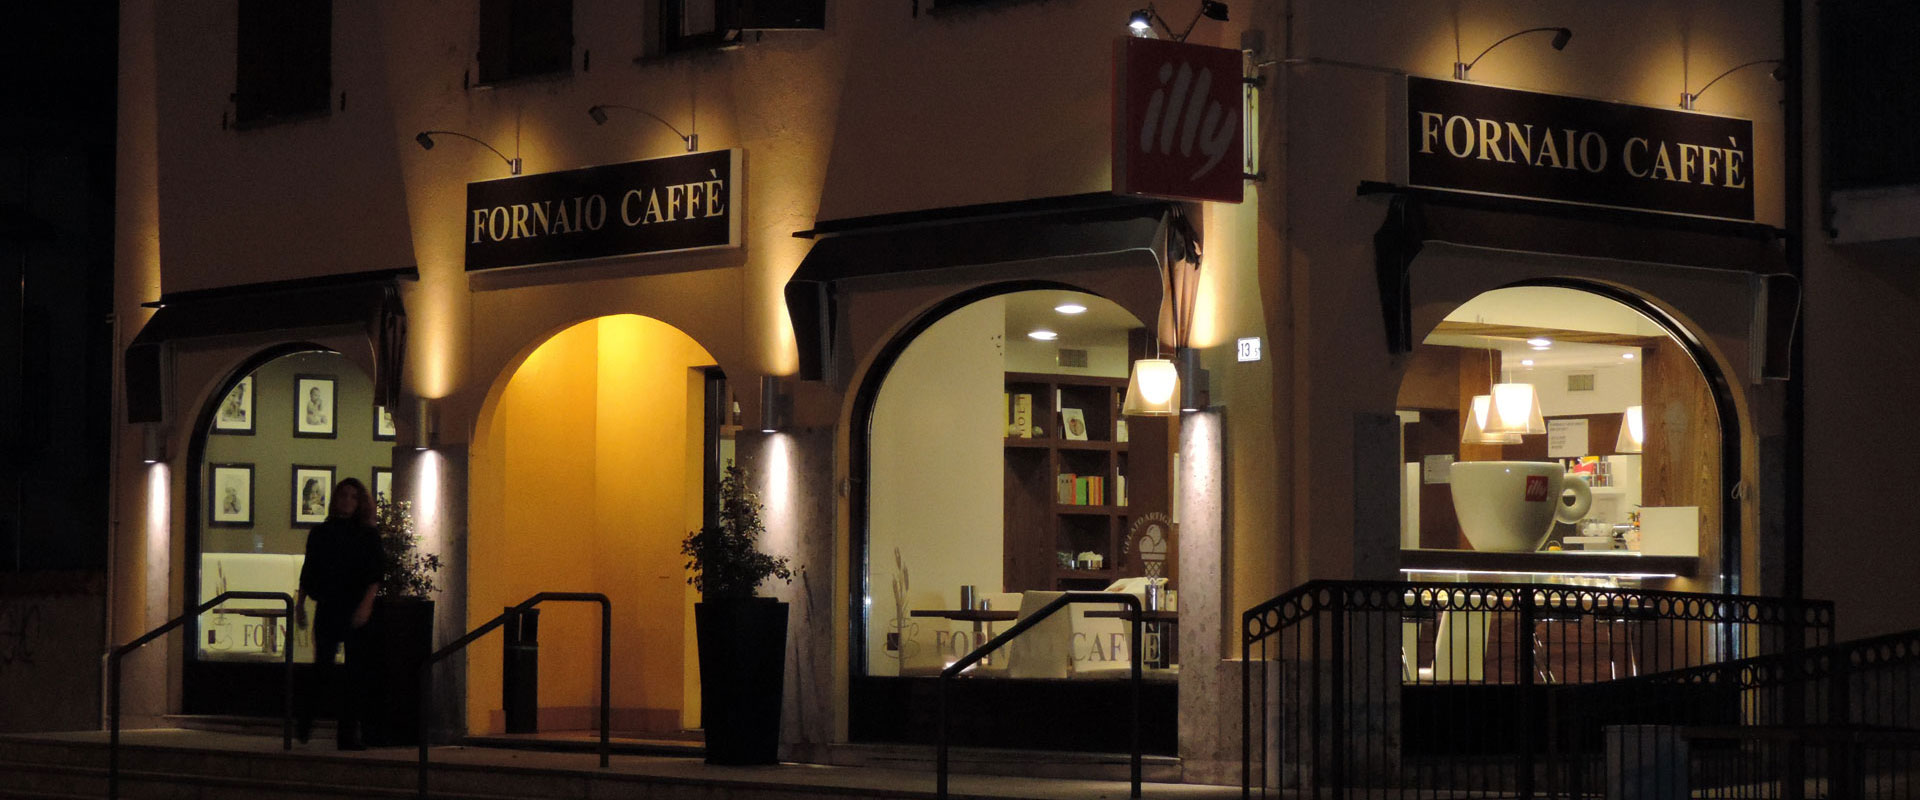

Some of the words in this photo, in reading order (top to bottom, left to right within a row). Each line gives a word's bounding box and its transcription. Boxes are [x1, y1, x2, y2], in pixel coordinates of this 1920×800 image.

[1140, 61, 1238, 182] illy
[1416, 110, 1609, 175] FORNAIO
[1622, 135, 1747, 190] CAFFÈ
[470, 192, 608, 244] FORNAIO
[620, 168, 726, 228] CAFFÈ
[1241, 342, 1251, 358] 13
[1526, 478, 1547, 498] illy
